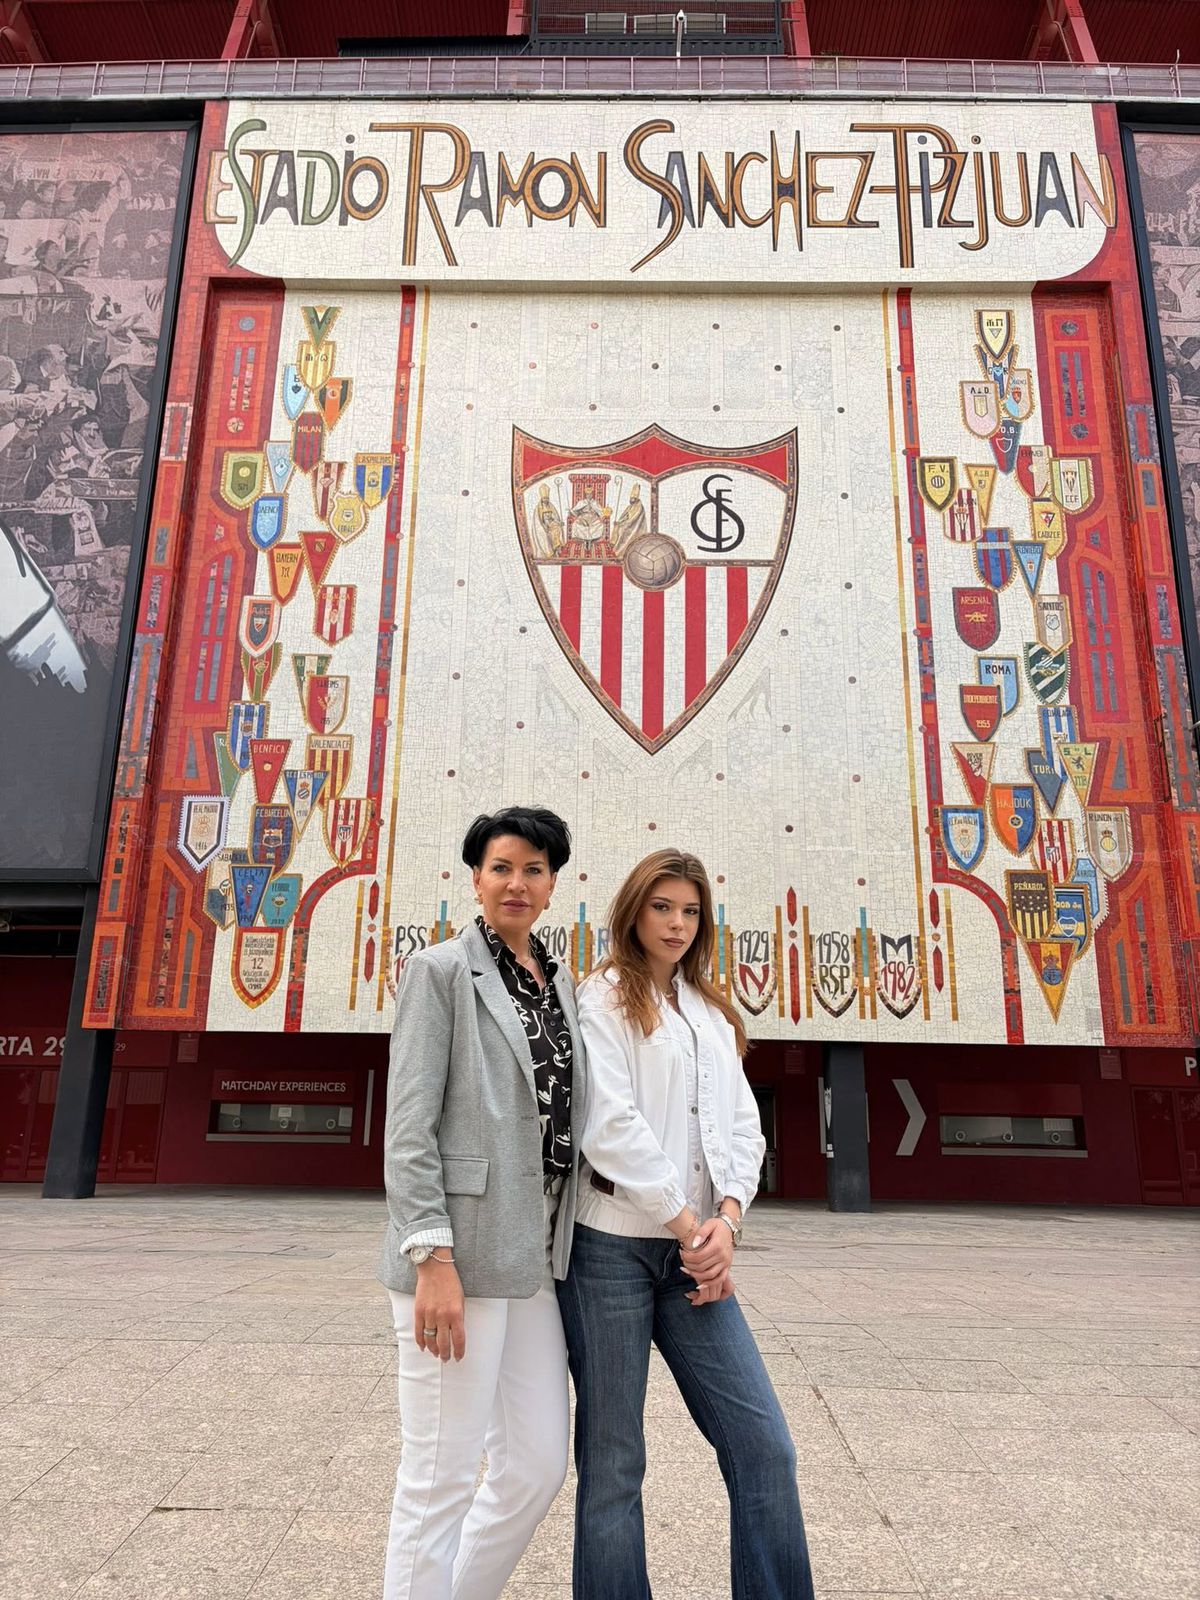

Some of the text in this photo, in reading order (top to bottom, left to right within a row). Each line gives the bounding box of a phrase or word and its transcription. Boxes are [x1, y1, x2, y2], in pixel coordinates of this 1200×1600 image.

[369, 121, 608, 267] RAMON
[297, 425, 322, 433] MILAN
[960, 596, 991, 605] ARSENAL
[1038, 601, 1065, 611] SANTOS
[985, 664, 1012, 675] ROMA
[253, 744, 285, 753] BENFICA
[239, 869, 265, 878] CELTA
[1013, 882, 1046, 891] PEÑAROL
[736, 930, 769, 964] 1929
[816, 931, 850, 964] 1958
[251, 957, 264, 970] 12
[880, 960, 916, 1001] 1982
[115, 1042, 126, 1052] 29
[220, 1080, 347, 1092] MATCHDAY EXPERIENCES
